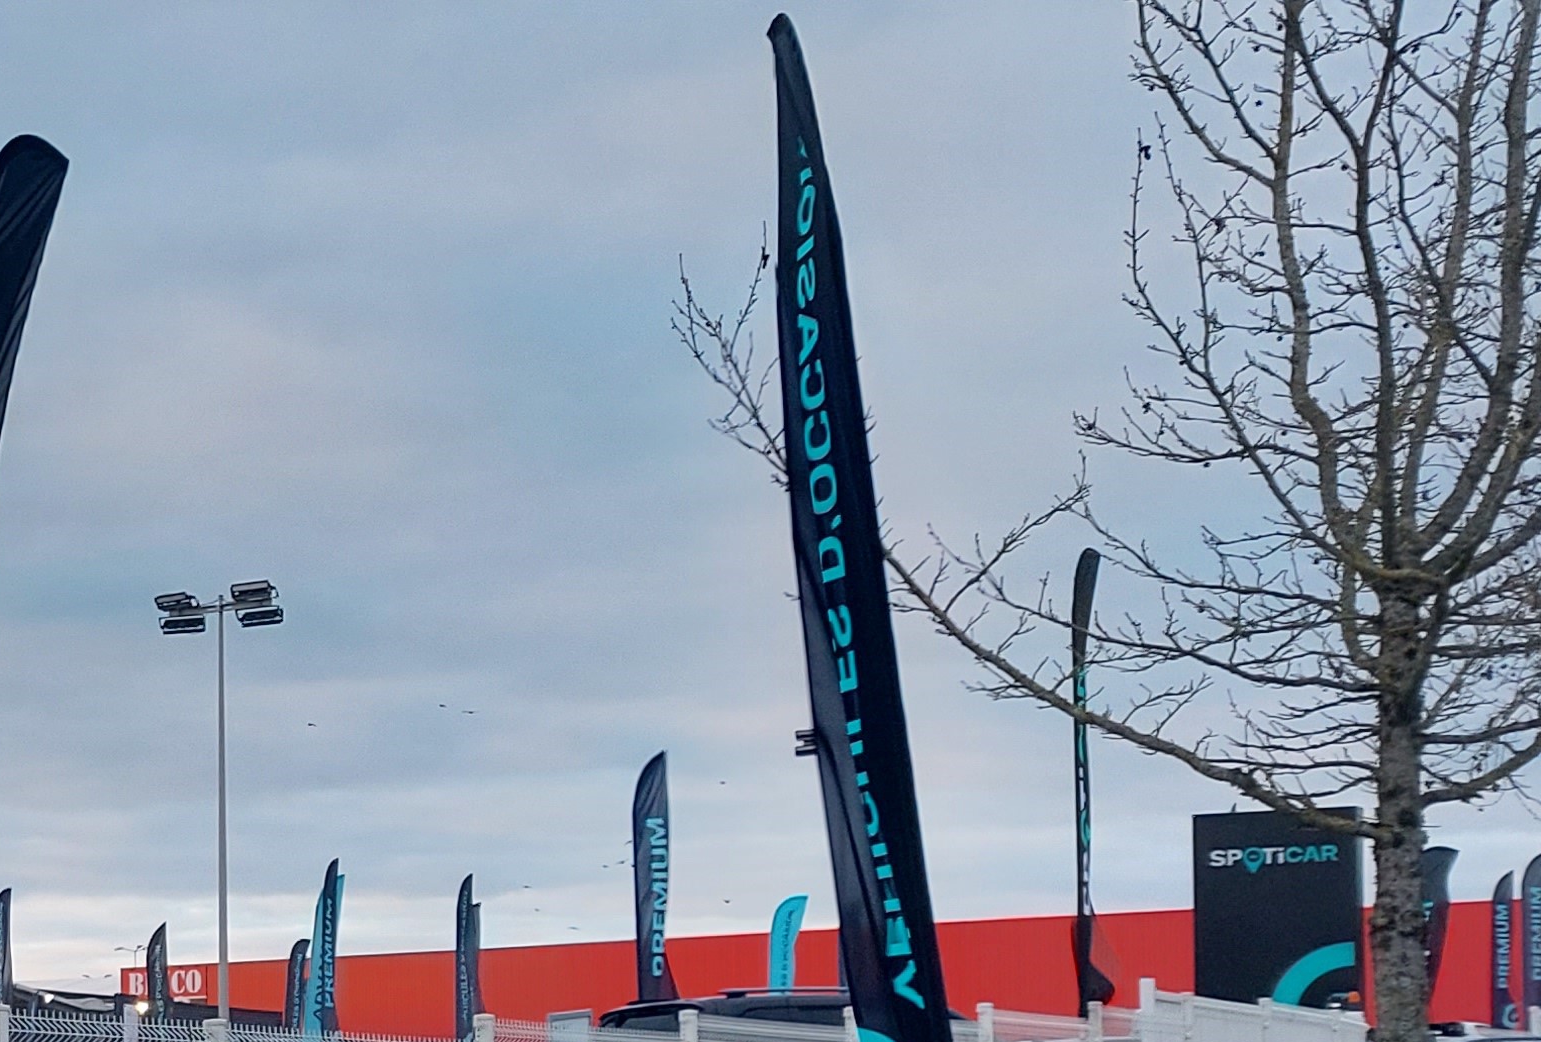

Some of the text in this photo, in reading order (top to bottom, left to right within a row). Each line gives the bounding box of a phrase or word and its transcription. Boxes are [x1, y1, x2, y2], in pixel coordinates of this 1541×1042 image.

[645, 817, 668, 977] PREMIUM
[128, 969, 202, 996] BCO
[324, 899, 334, 1009] PREMIUM
[1494, 904, 1510, 989] PREMIUM
